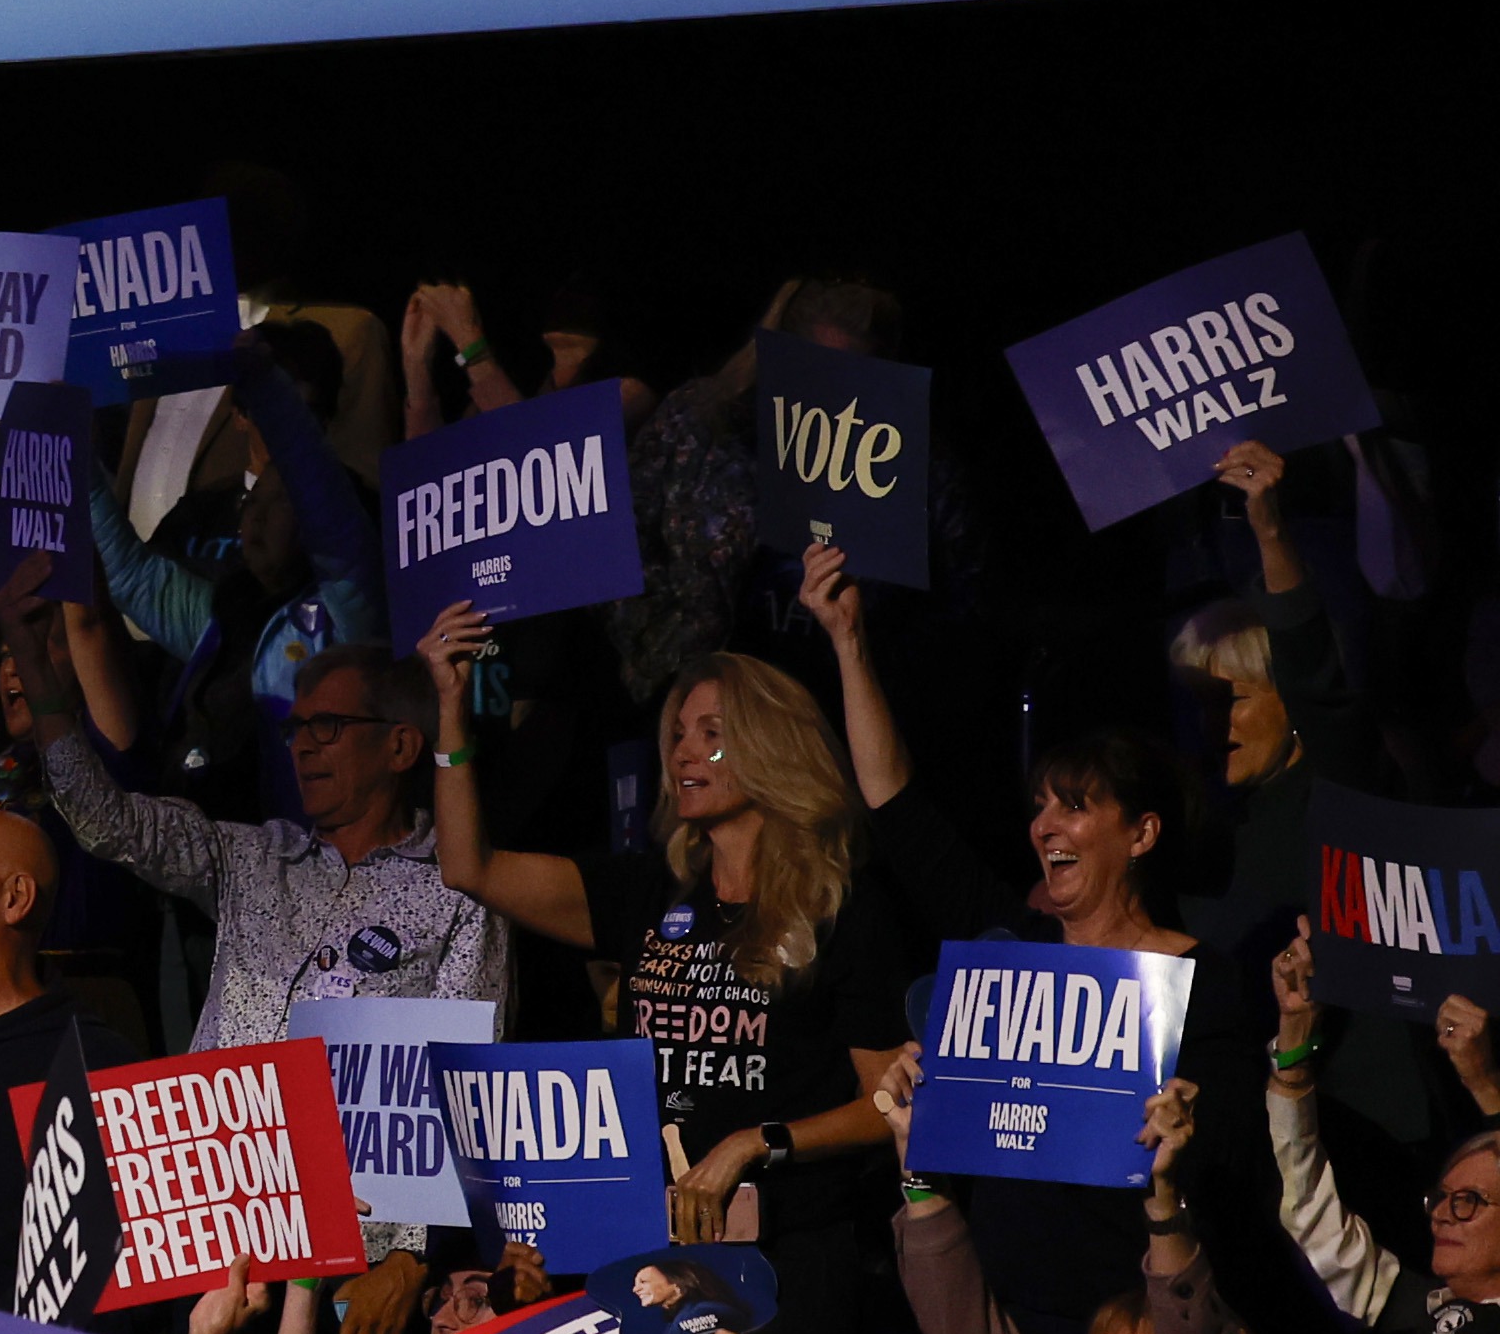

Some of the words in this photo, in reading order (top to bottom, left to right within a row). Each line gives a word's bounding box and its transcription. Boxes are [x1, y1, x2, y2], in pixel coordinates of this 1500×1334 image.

[1076, 291, 1295, 428] HARRIS
[1135, 367, 1289, 453] WALZ
[1, 429, 73, 507] HARRIS
[773, 395, 902, 500] vote
[397, 436, 609, 569] FREEDOM
[11, 507, 66, 553] WALZ
[471, 556, 513, 580] HARRIS
[477, 570, 506, 587] WALZ
[697, 986, 721, 1000] NOT
[724, 986, 770, 1006] CHAOS
[938, 968, 1140, 1072] NEVADA
[684, 1050, 767, 1091] FEAR
[1011, 1077, 1032, 1088] FOR
[442, 1068, 629, 1163] NEVADA
[988, 1101, 1049, 1135] HARRIS
[995, 1132, 1037, 1151] WALZ
[504, 1176, 522, 1188] FOR
